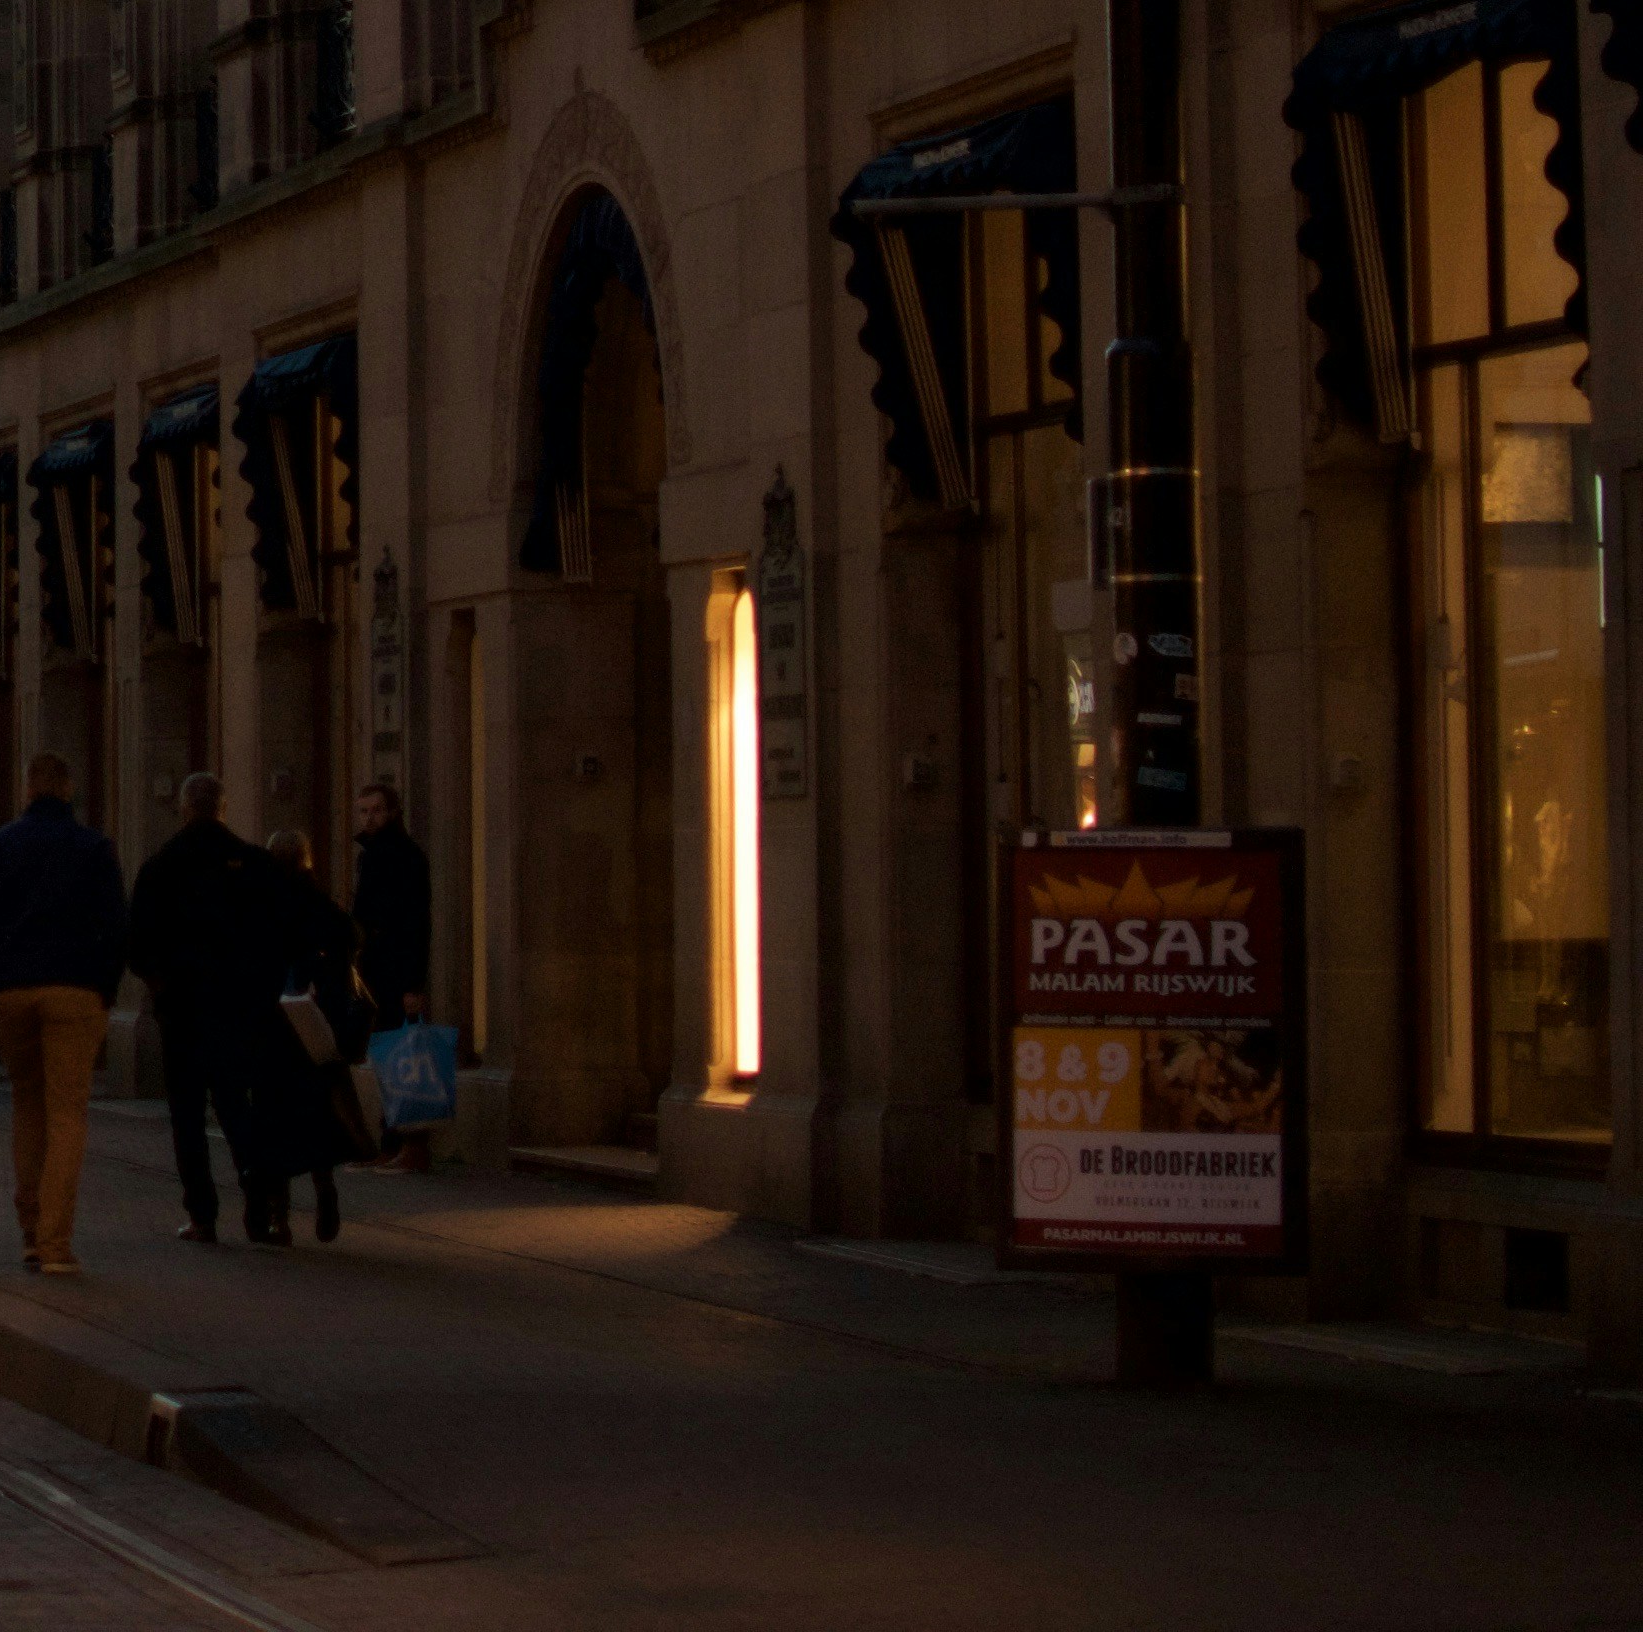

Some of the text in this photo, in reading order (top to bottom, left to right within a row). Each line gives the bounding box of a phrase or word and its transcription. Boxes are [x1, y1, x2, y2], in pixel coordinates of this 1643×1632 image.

[1029, 918, 1258, 968] PASAR
[1028, 972, 1257, 998] MALAM RIJSWIJK
[1015, 1039, 1132, 1085] 8 & 9
[1015, 1088, 1113, 1125] NOV
[1079, 1145, 1277, 1178] DE BROODFABRIEK
[1043, 1226, 1247, 1246] PASARMALAMRIJSWIJK.NL
